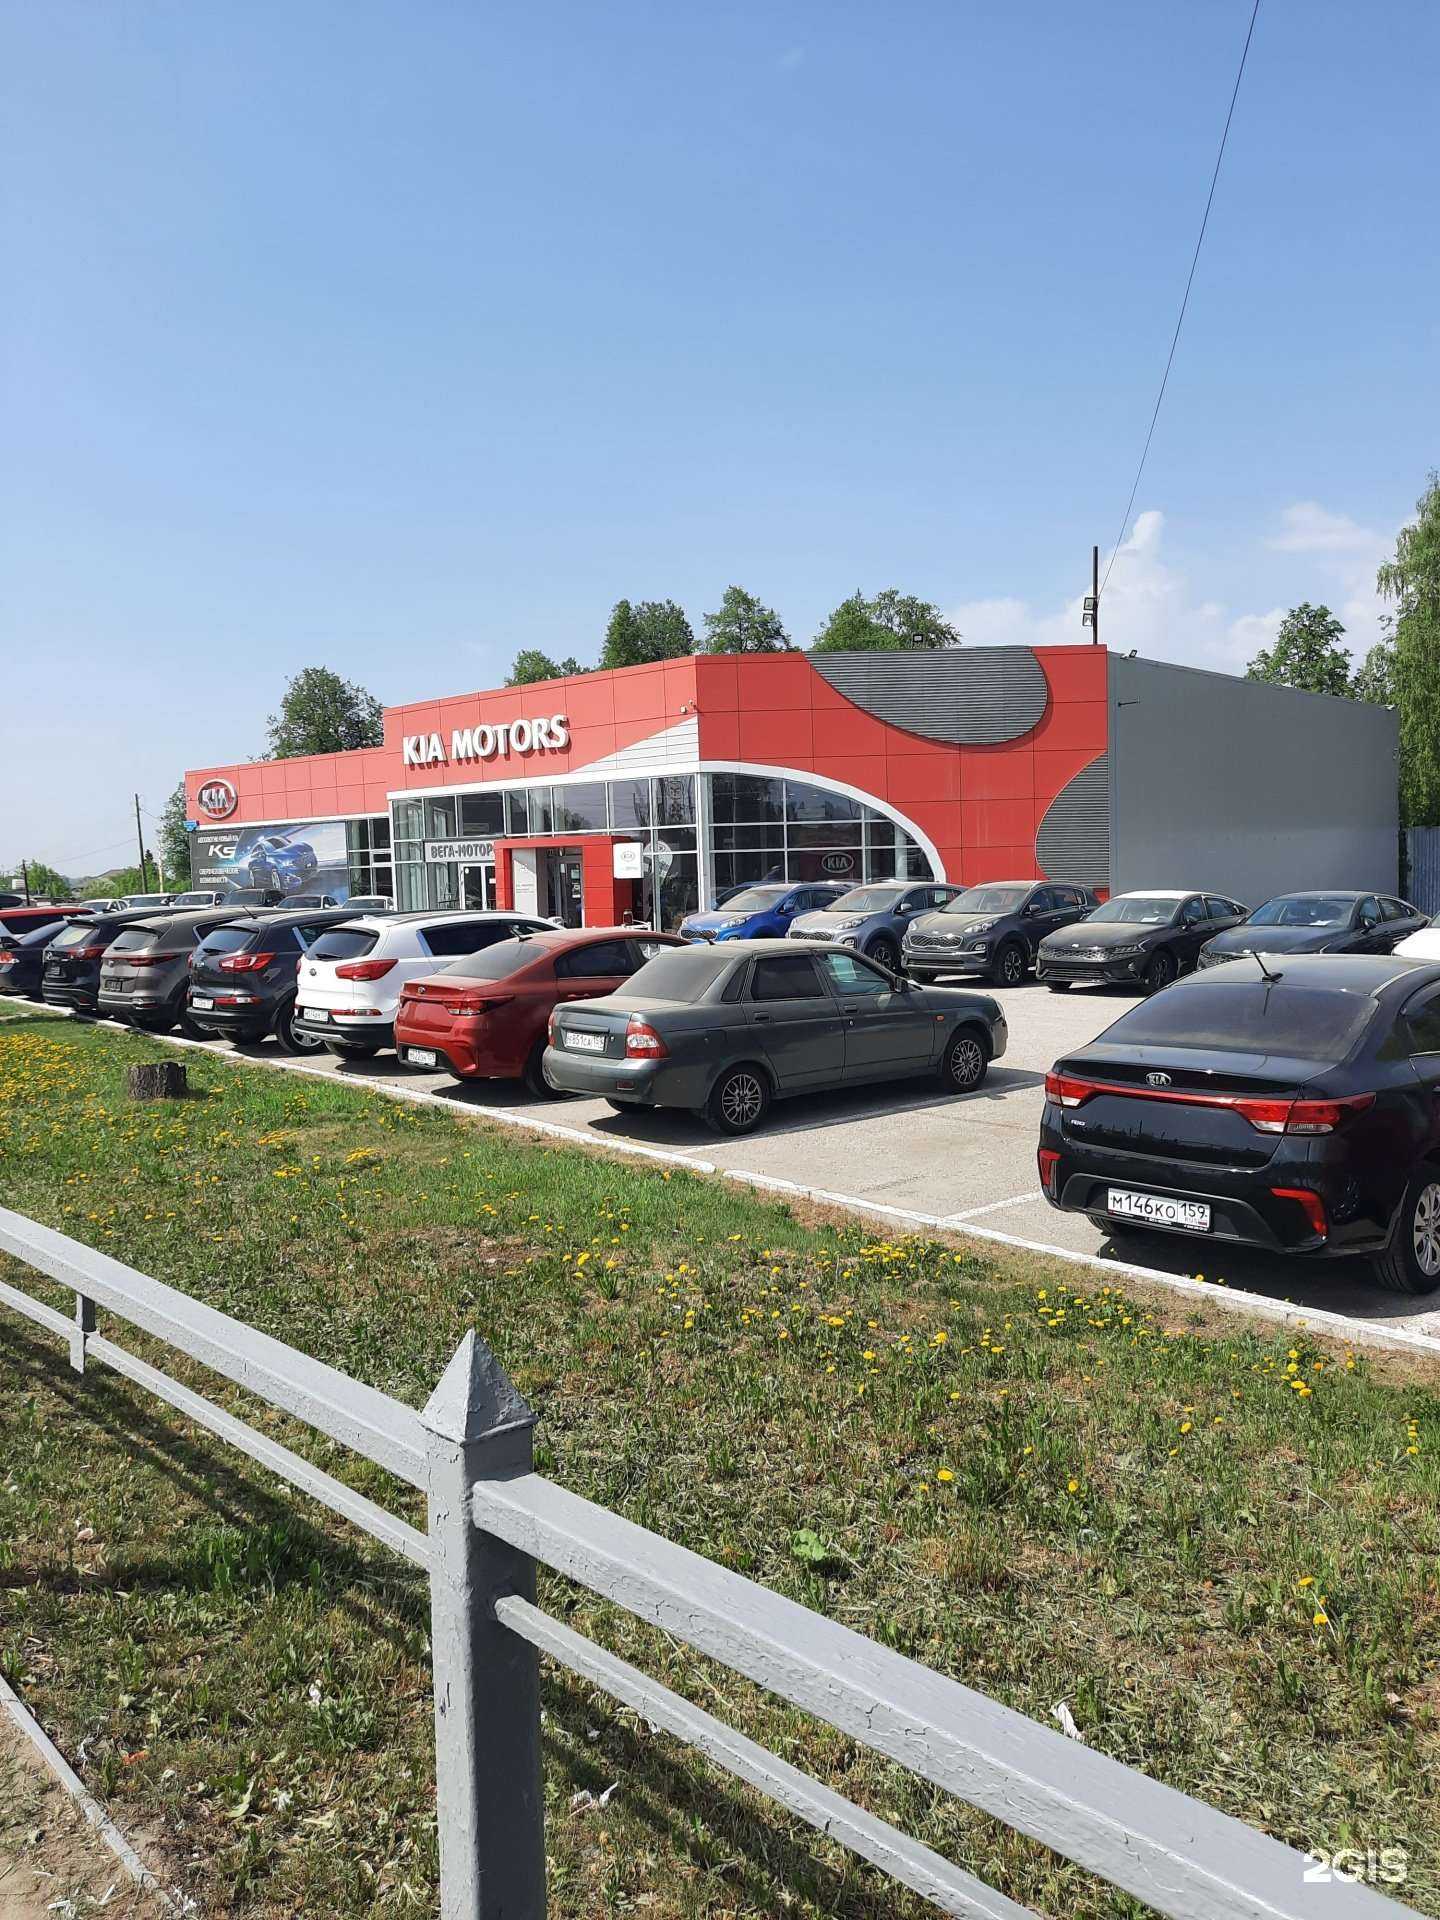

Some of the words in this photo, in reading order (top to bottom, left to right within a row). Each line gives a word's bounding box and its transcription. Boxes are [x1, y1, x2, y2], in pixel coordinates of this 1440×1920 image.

[402, 733, 447, 765] KIA
[451, 714, 571, 760] MOTORS
[202, 787, 228, 809] KIA
[1180, 1202, 1205, 1219] 159
